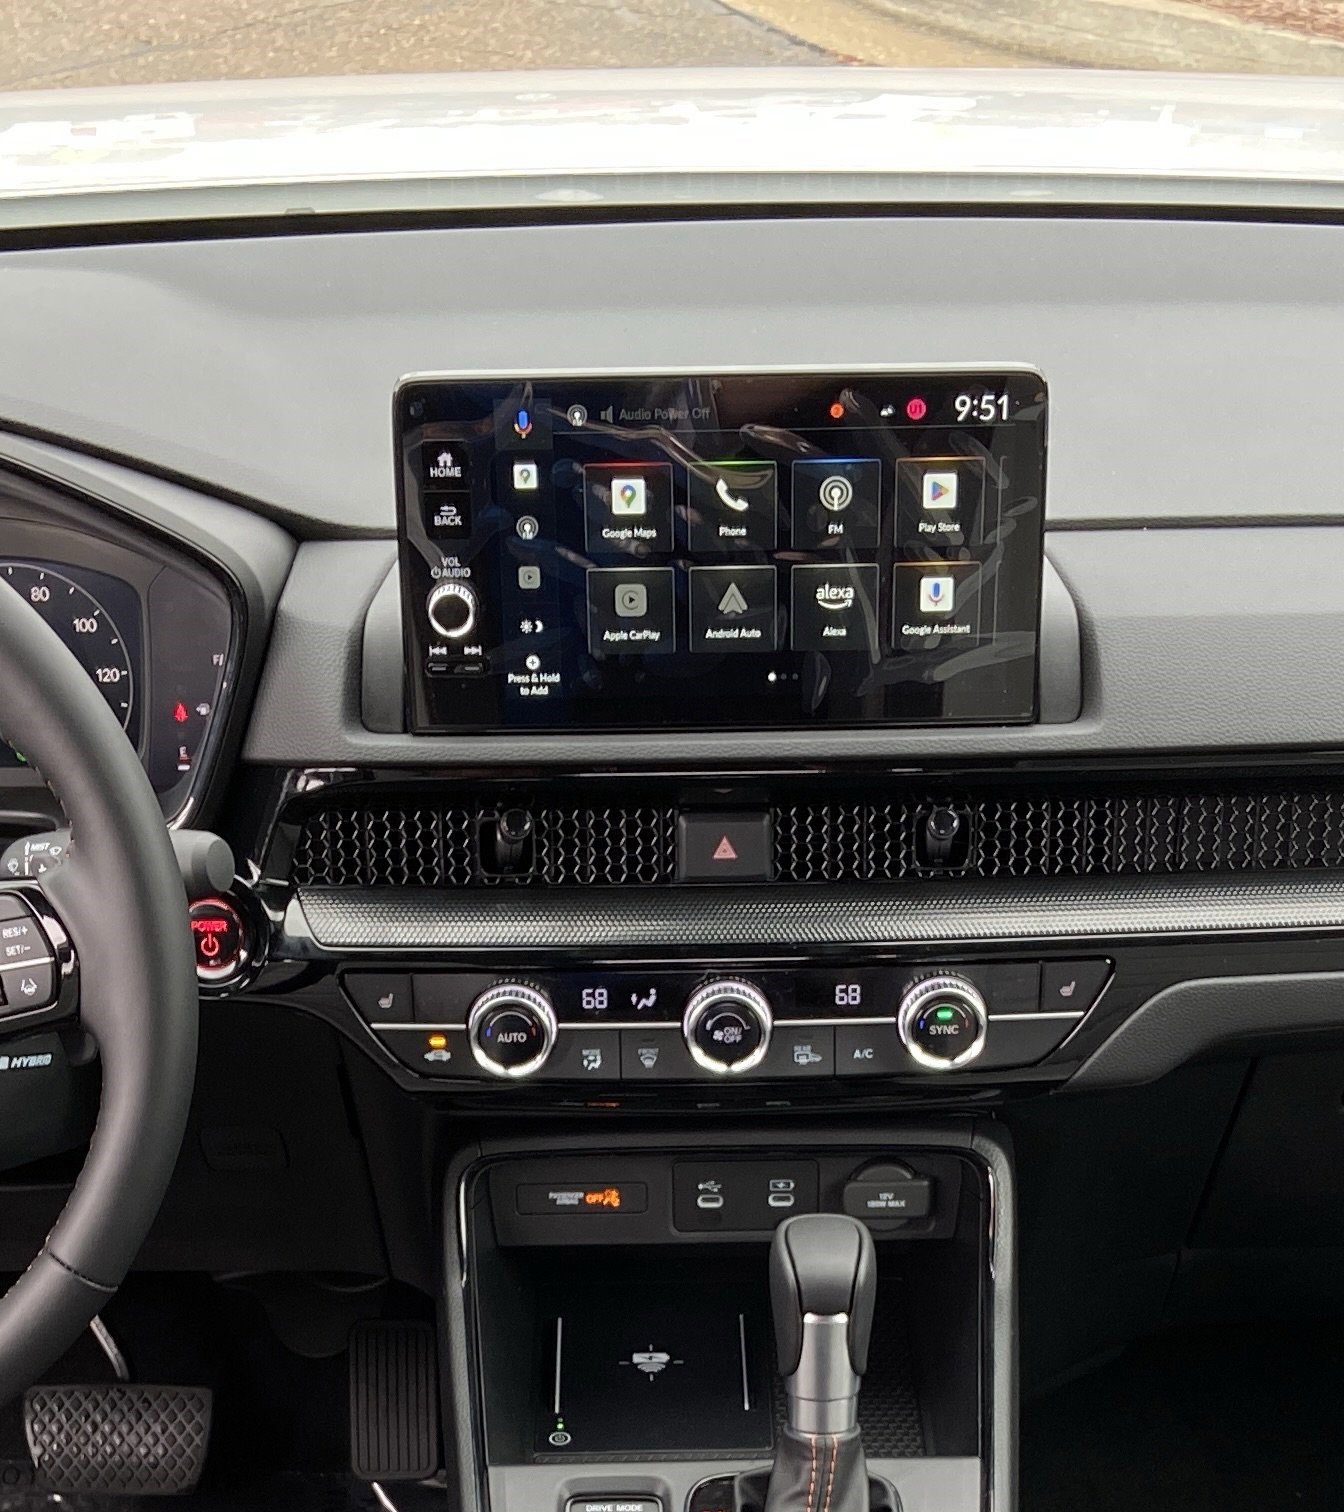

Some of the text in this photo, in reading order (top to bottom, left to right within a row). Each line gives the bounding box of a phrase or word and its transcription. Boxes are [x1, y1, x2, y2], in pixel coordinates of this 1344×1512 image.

[619, 407, 652, 420] Audio
[692, 406, 712, 420] Off
[954, 393, 1009, 422] 9:51
[429, 466, 462, 478] HOME
[434, 515, 462, 527] BACK
[918, 521, 960, 534] Play Store
[602, 527, 657, 540] Google Maps
[718, 525, 747, 537] Phone
[827, 523, 844, 535] FM
[441, 556, 462, 568] VOL
[442, 567, 472, 578] AUDIO
[30, 586, 50, 602] 80
[815, 581, 855, 600] alexa
[72, 616, 98, 634] 100
[822, 624, 847, 637] Alexa
[901, 623, 971, 636] Google Assistant
[603, 629, 661, 642] Apple CarPlay
[705, 626, 762, 640] Android Auto
[95, 667, 121, 683] 120
[540, 672, 561, 684] Hold
[520, 685, 549, 696] to Add
[190, 919, 228, 933] POWER
[581, 988, 608, 1010] 68
[835, 984, 861, 1005] 68
[928, 1024, 960, 1036] SYNC
[496, 1031, 527, 1043] AUTO
[853, 1048, 874, 1060] A/C
[586, 1193, 605, 1204] OFF
[585, 1503, 644, 1512] DRIVE MODE
